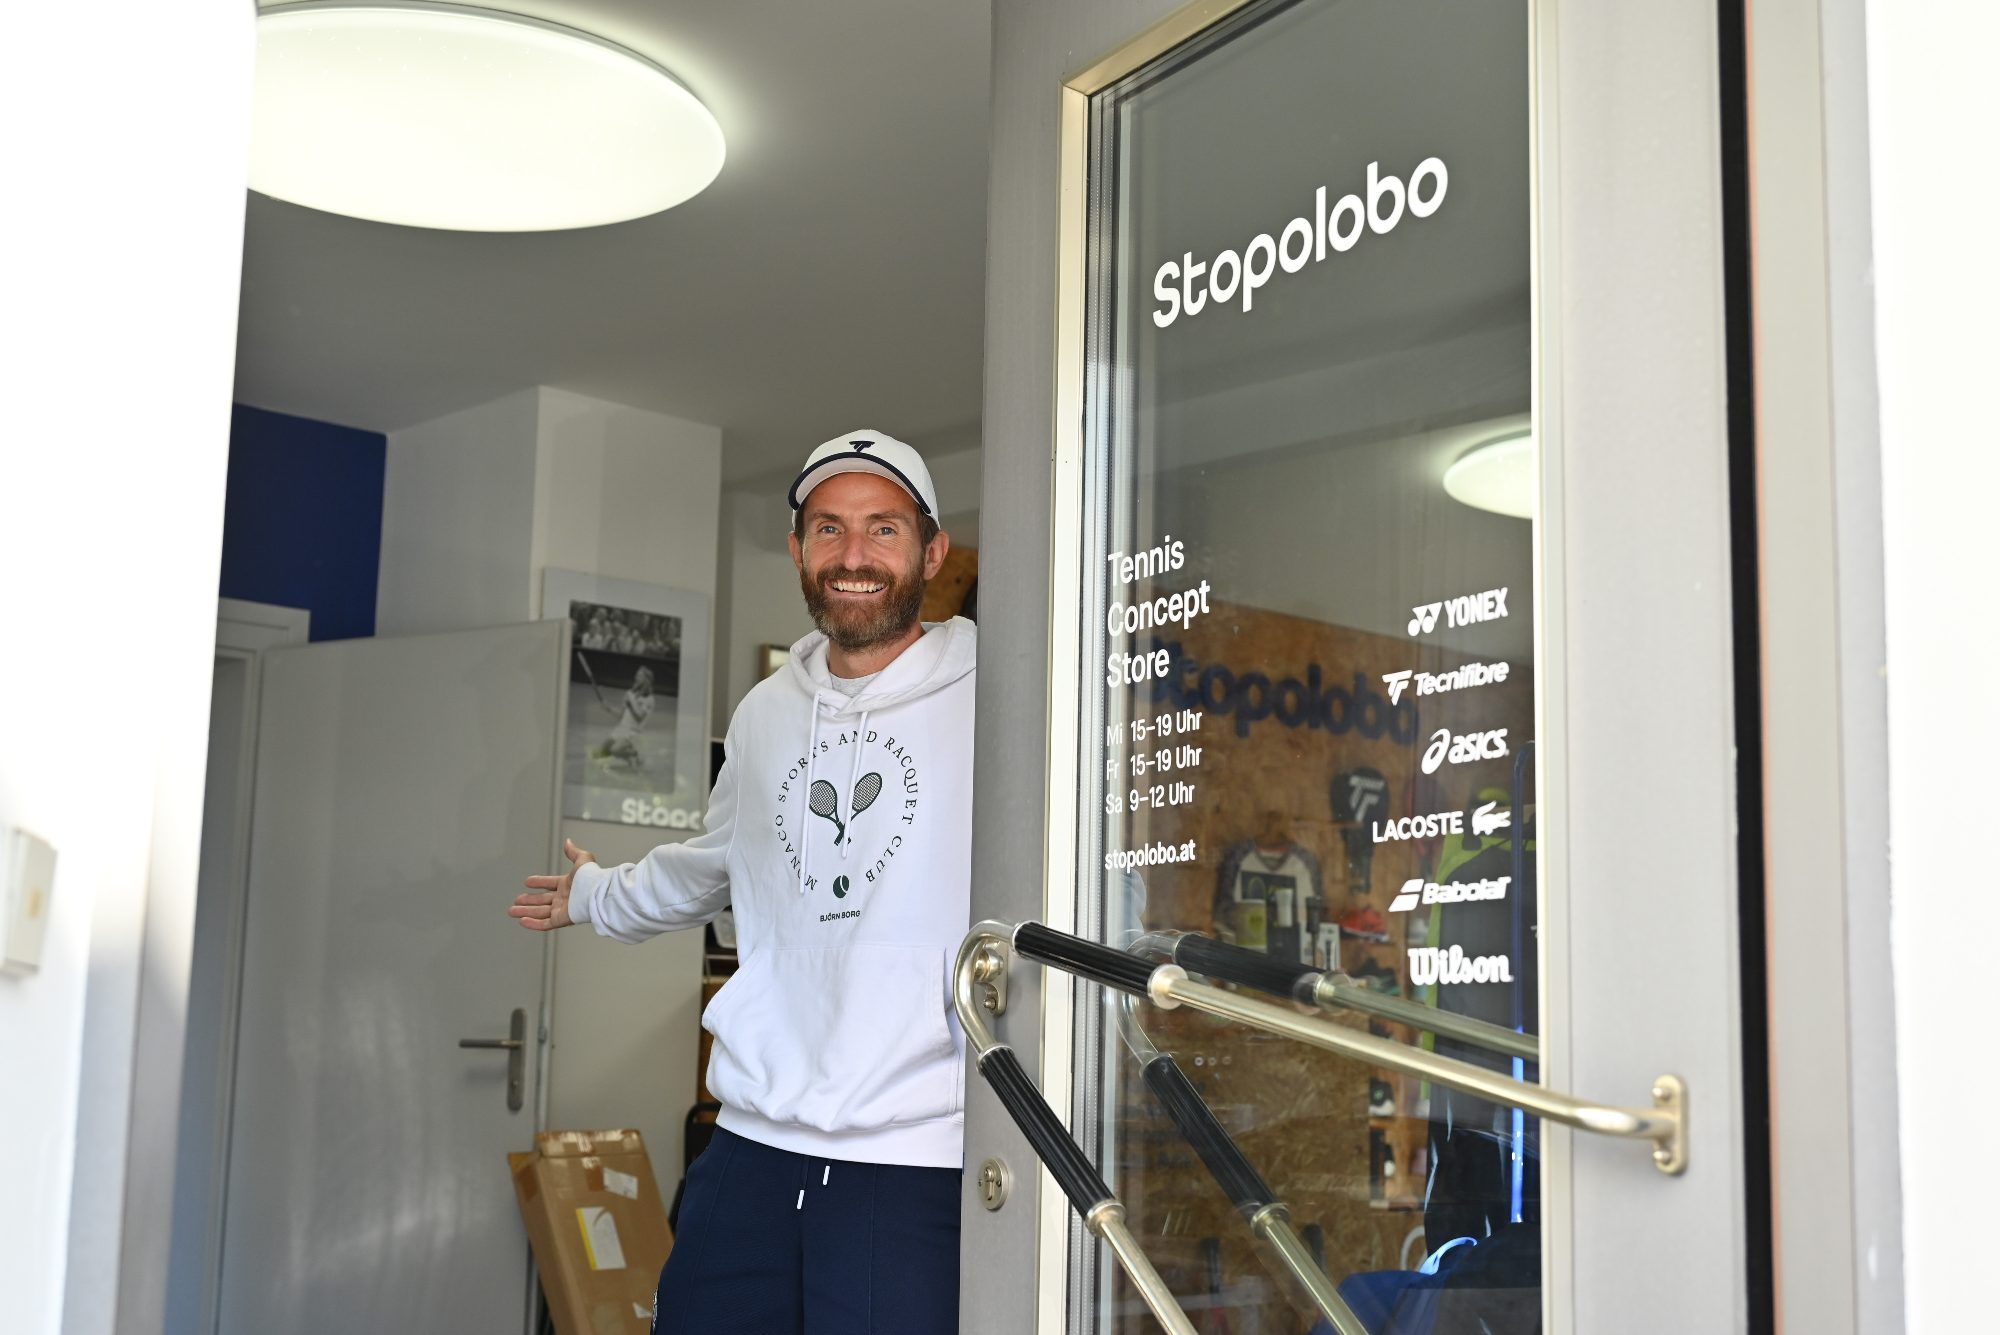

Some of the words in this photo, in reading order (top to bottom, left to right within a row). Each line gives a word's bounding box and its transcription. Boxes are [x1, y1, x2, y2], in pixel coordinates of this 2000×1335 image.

[1152, 157, 1448, 328] Stopolobo
[1108, 535, 1185, 586] Tennis
[1108, 580, 1211, 637] Concept
[1444, 587, 1509, 629] YONEX
[1107, 649, 1170, 688] Store
[1414, 661, 1510, 697] Tecnifibre
[1106, 723, 1123, 747] Mi
[1176, 709, 1203, 734] Uhr
[884, 736, 918, 825] RACQUET
[1106, 759, 1120, 781] Fr
[1176, 744, 1203, 769] Uhr
[1105, 793, 1123, 815] Sa
[1168, 780, 1196, 806] Uhr
[1372, 810, 1465, 843] LACOSTE
[865, 835, 903, 882] CLUB
[1104, 838, 1197, 874] stopolobo.at
[841, 910, 861, 919] BORG
[1407, 944, 1513, 986] Wilson
